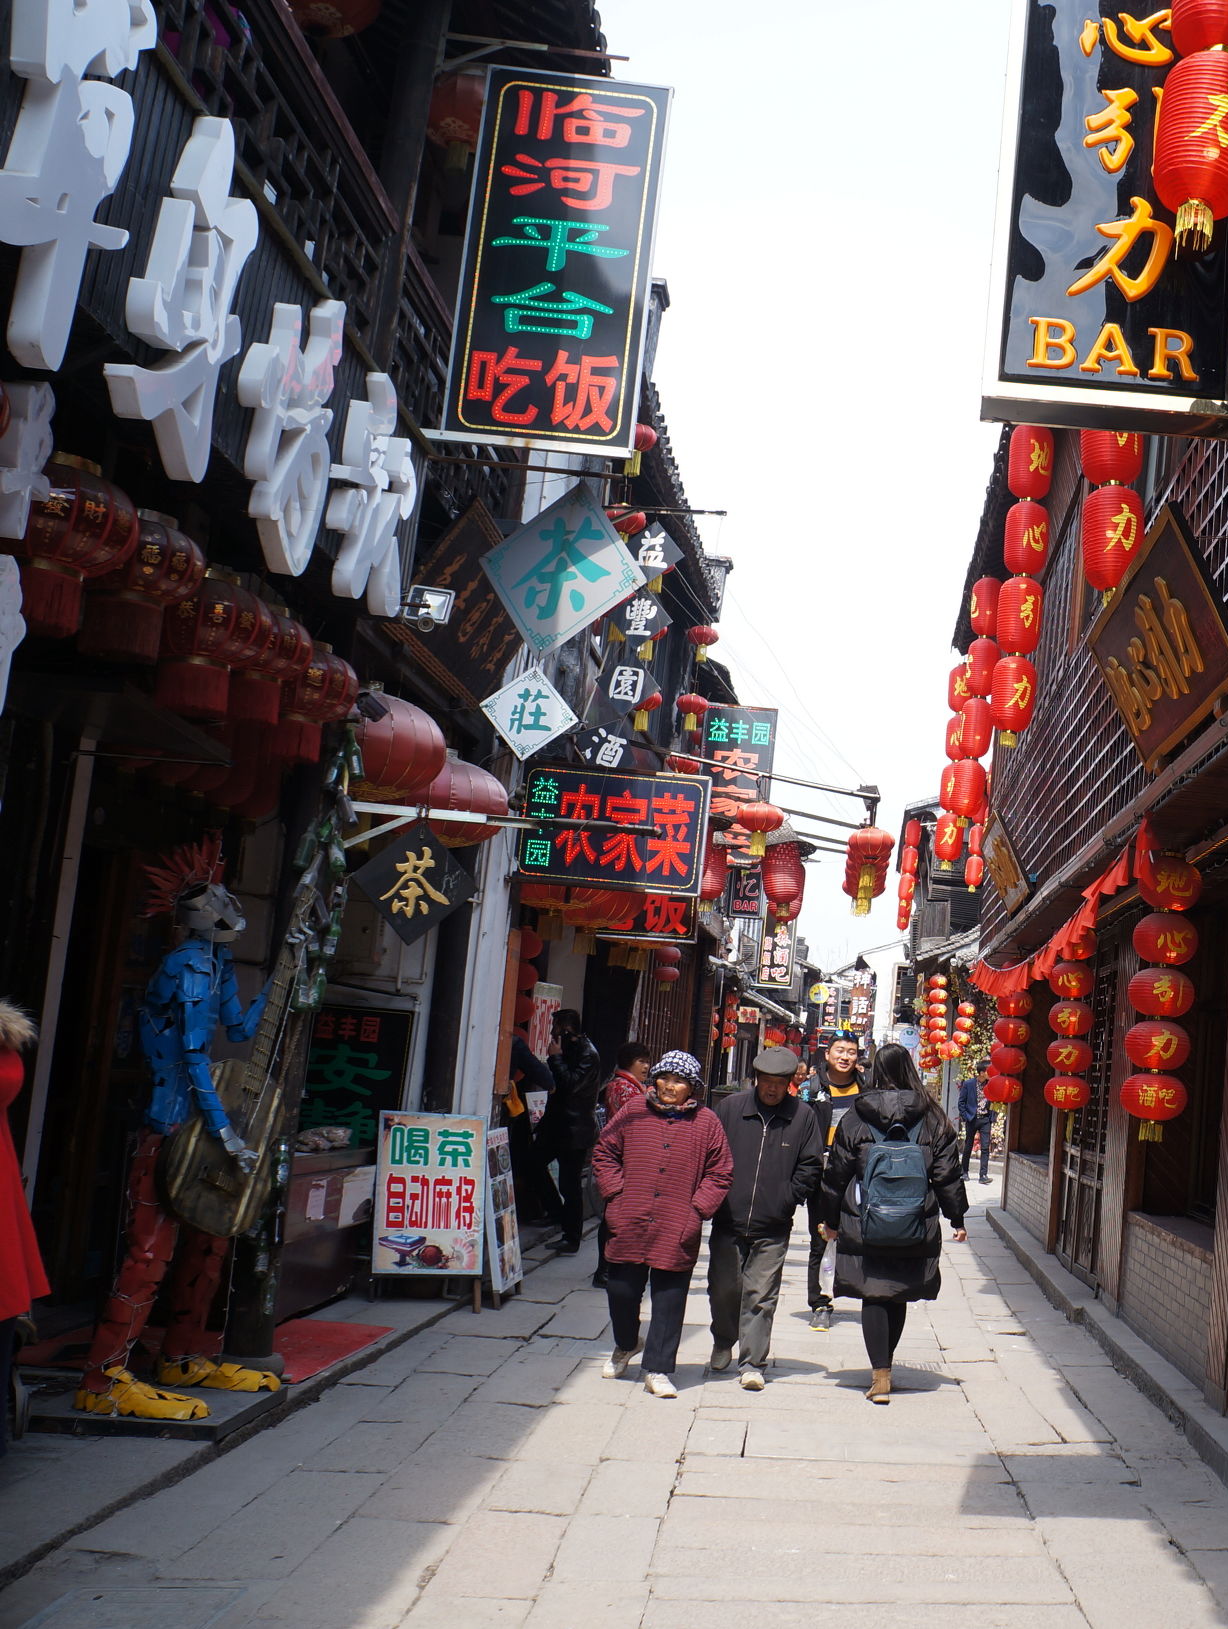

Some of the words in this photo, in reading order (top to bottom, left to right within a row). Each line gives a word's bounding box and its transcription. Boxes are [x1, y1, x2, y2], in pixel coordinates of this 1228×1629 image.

[490, 90, 646, 339] 临河平台
[1026, 316, 1199, 382] BAR
[468, 346, 621, 433] 吃饭
[1104, 502, 1138, 553] 力
[511, 516, 612, 620] 茶
[638, 530, 669, 569] 益
[625, 597, 659, 636] 豐
[608, 665, 646, 704] 園
[1004, 674, 1032, 709] 力
[586, 728, 628, 769] 酒
[708, 717, 771, 745] 益丰园
[554, 783, 696, 877] 农家菜
[379, 846, 451, 919] 茶
[733, 899, 759, 912] BAR
[1157, 929, 1193, 954] 心
[1152, 975, 1184, 1009] 引
[850, 1015, 867, 1025] Bar
[1056, 1007, 1080, 1032] 引
[1054, 1044, 1079, 1066] 力
[1144, 1028, 1179, 1060] 力
[1053, 1085, 1081, 1103] 酒吧
[1138, 1078, 1177, 1109] 酒吧
[390, 1126, 475, 1168] 喝茶
[386, 1172, 476, 1231] 自动麻将
